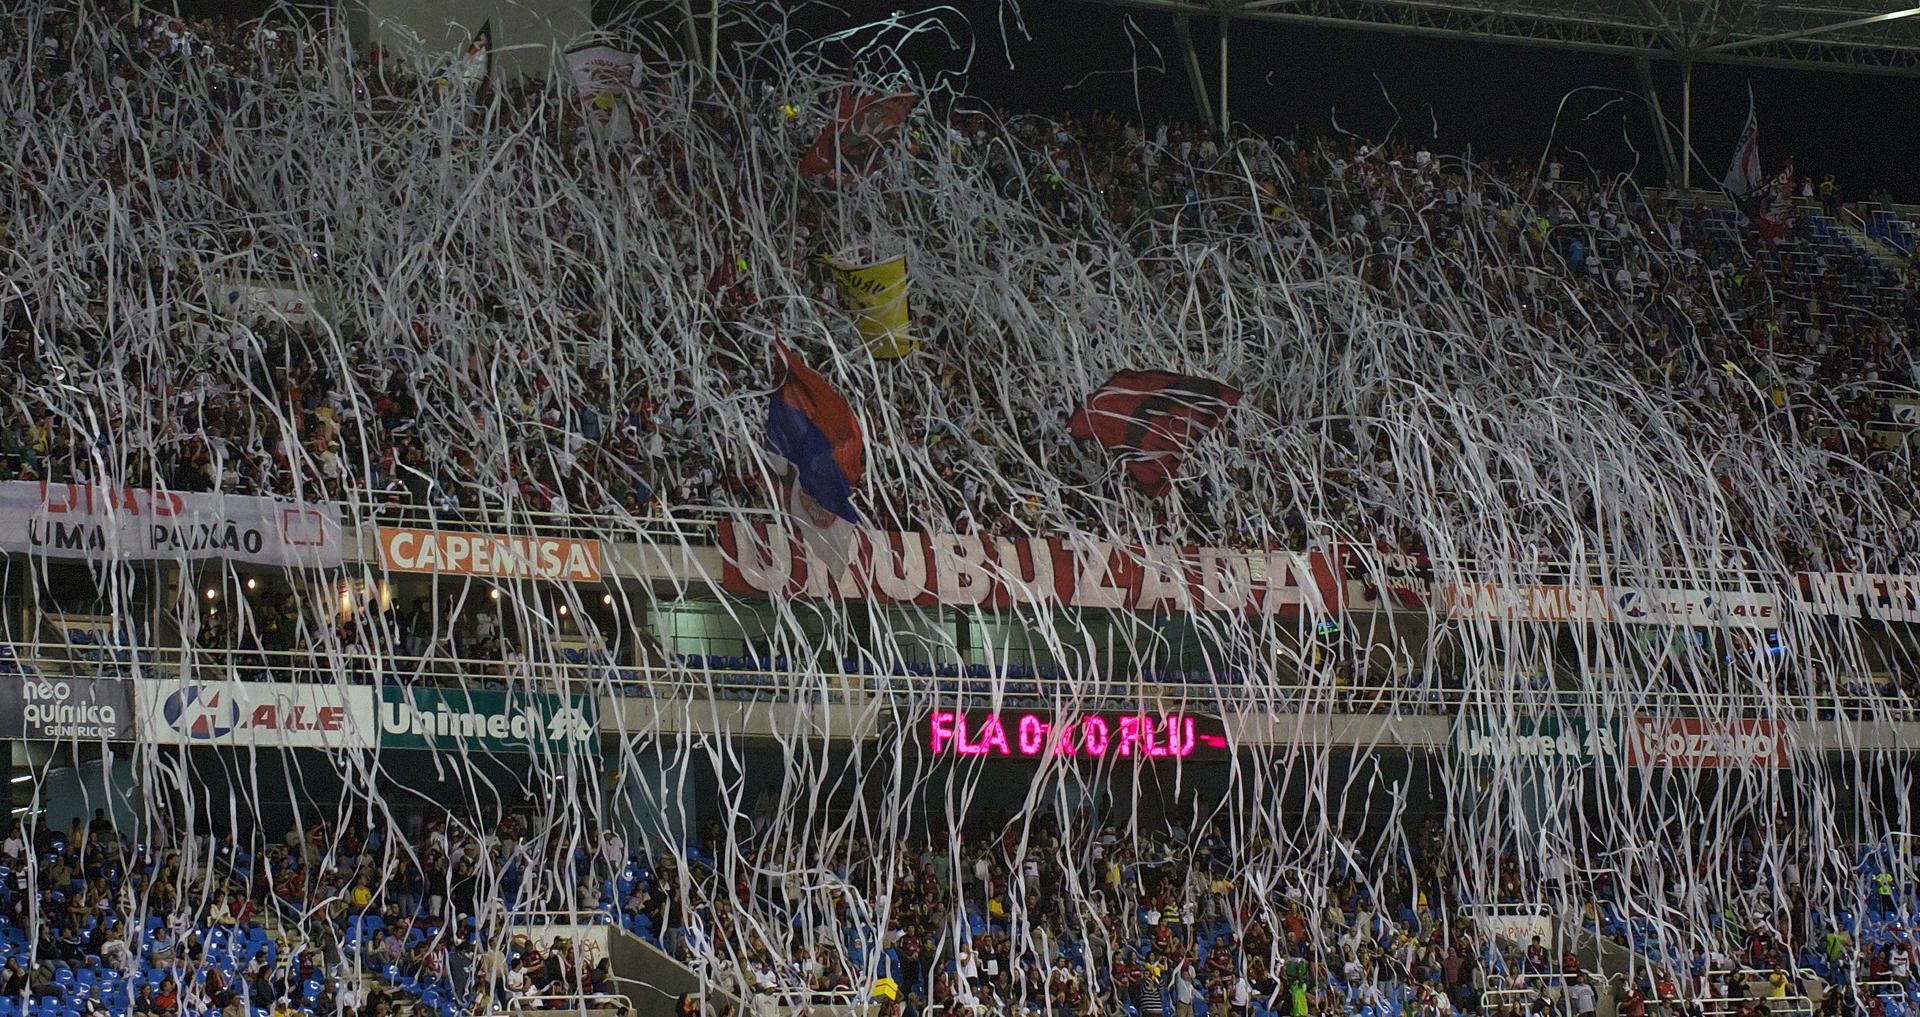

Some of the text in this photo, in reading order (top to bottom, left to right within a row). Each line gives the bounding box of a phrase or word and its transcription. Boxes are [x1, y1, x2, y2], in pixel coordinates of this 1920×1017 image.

[29, 518, 263, 553] UMA PAIXÃO
[390, 533, 592, 578] CAPEMISA
[1730, 605, 1773, 617] ALE
[23, 681, 70, 700] neo
[24, 701, 116, 729] química
[240, 704, 346, 731] ALE
[383, 702, 536, 739] Unimed
[44, 725, 116, 738] GENRICS
[931, 713, 1010, 755] FLA
[1120, 714, 1195, 756] FLU
[1458, 727, 1576, 756] Unmed
